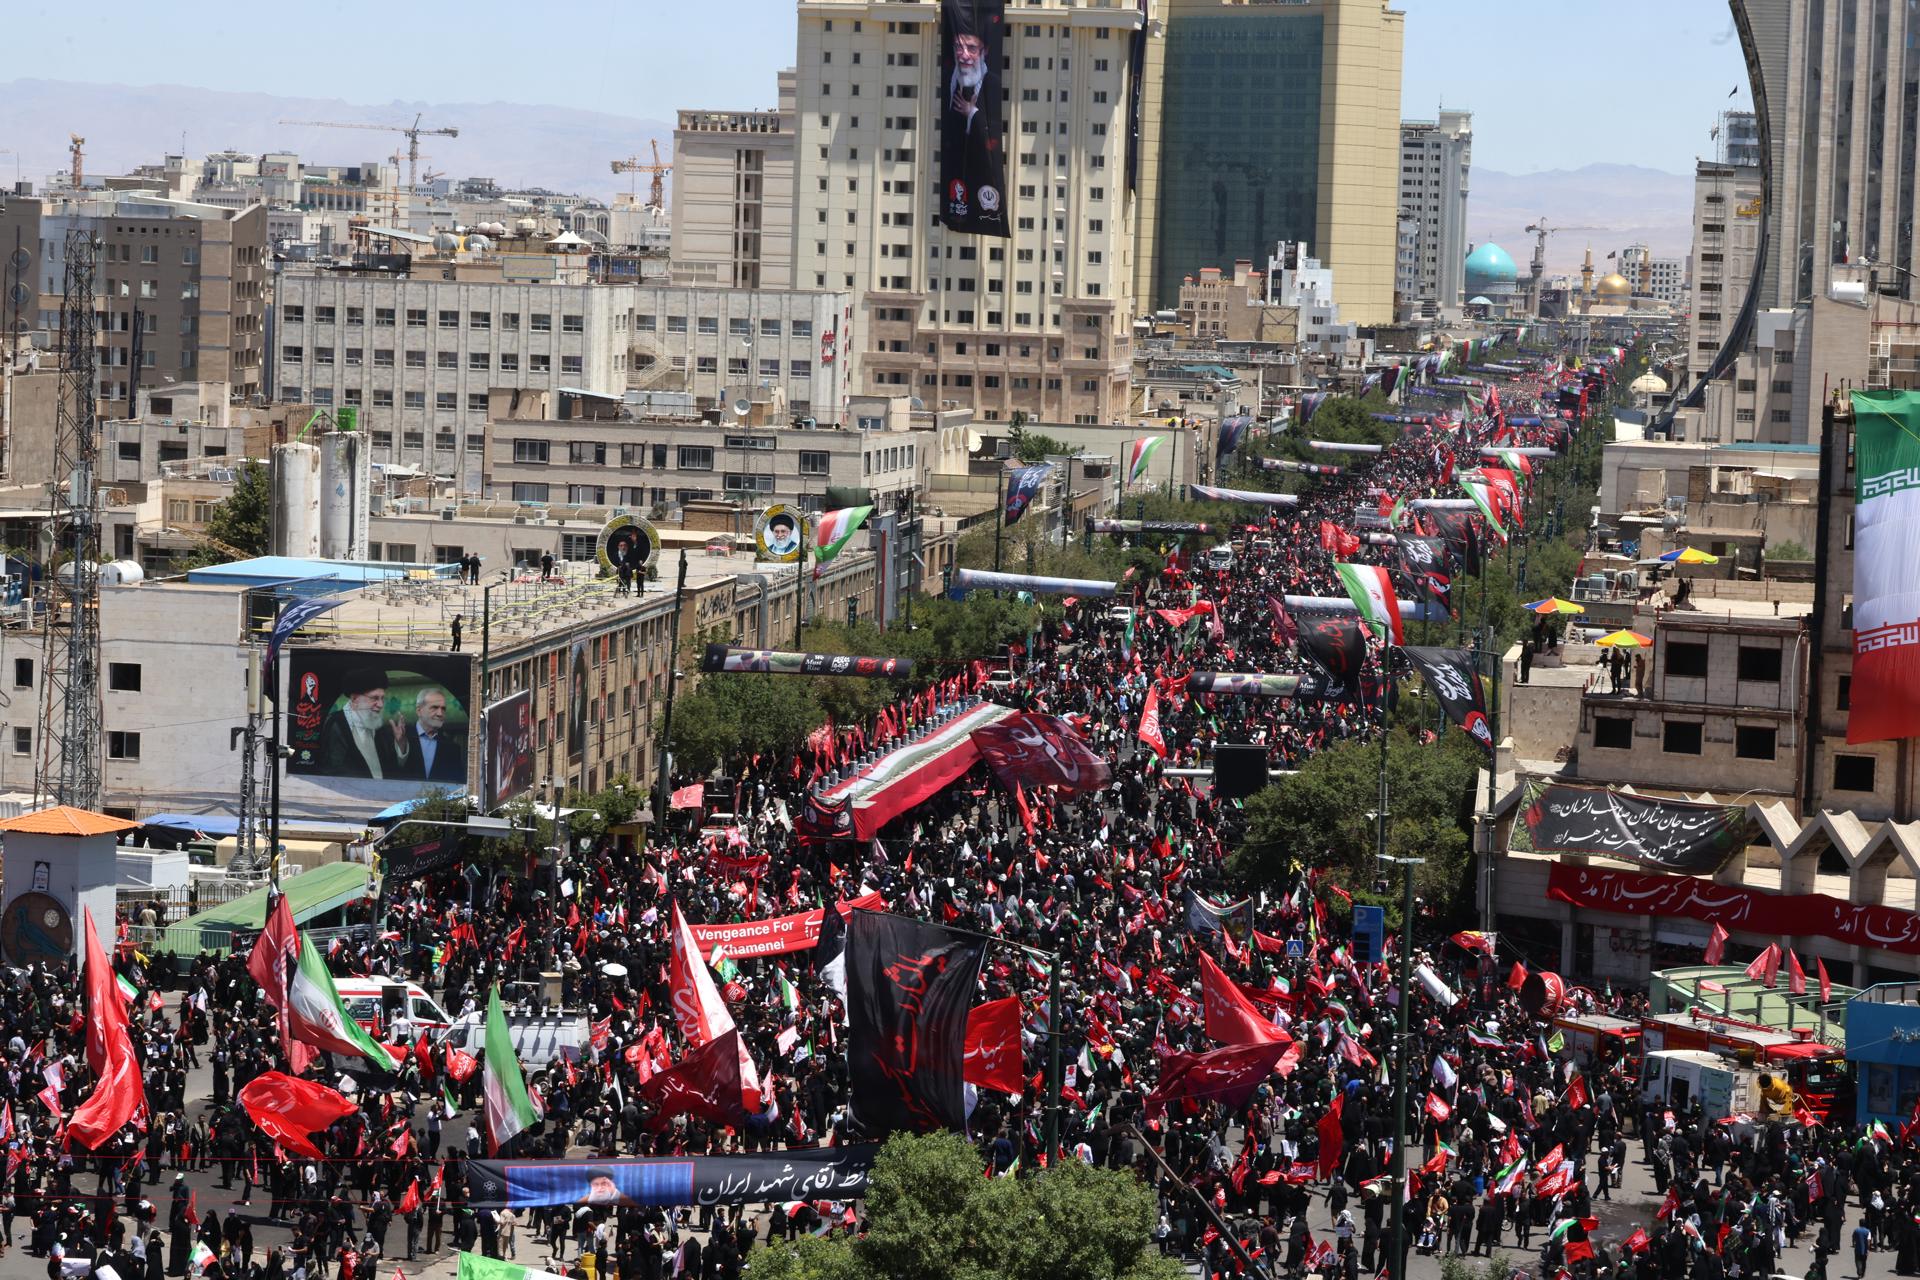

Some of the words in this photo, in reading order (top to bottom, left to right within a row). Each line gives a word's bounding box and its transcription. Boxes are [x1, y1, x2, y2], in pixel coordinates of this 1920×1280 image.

[804, 658, 823, 667] Must
[1354, 909, 1367, 926] P
[697, 924, 770, 942] Vengeance
[772, 920, 794, 935] For
[721, 938, 785, 957] Khamenei
[697, 1172, 752, 1205] ایران
